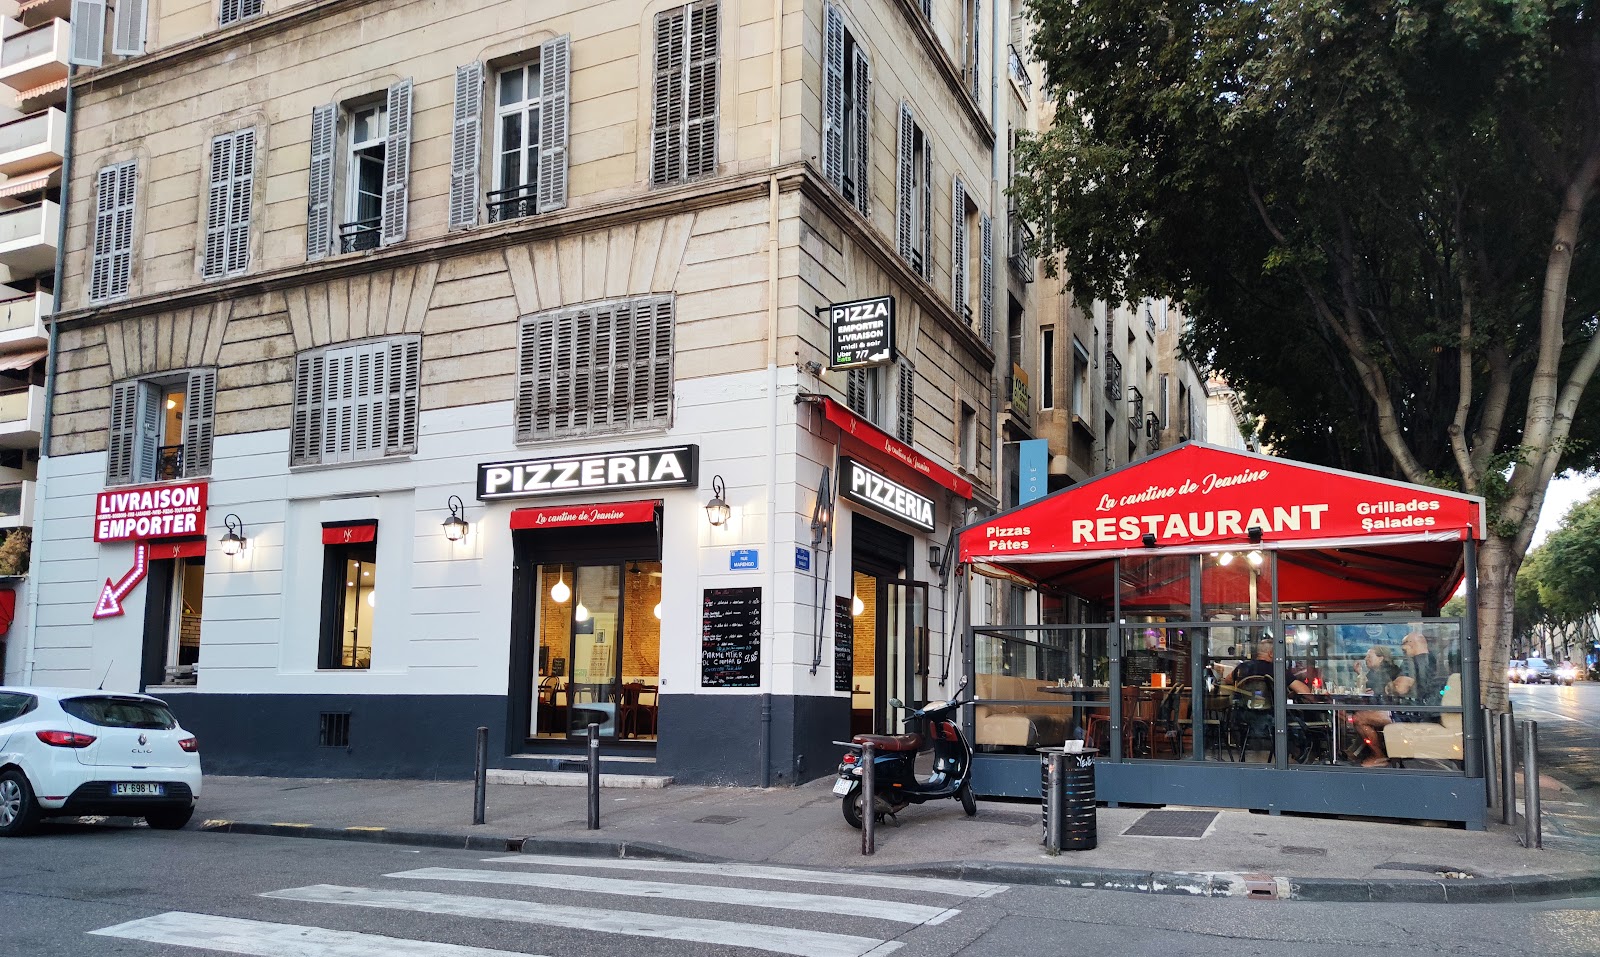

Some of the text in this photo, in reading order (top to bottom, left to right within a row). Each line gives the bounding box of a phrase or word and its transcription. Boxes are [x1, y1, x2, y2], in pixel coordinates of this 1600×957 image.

[834, 302, 888, 323] PIZZA
[838, 320, 884, 333] EMPORTER
[838, 330, 883, 342] LIVRAISON
[856, 350, 869, 359] 7/7
[486, 453, 684, 493] PIZZERIA
[852, 466, 933, 525] PIZZERIA
[1096, 468, 1269, 512] La cantine de Jeanine
[100, 487, 199, 513] LIVRAISON
[1356, 499, 1440, 516] Grillades
[535, 509, 624, 524] La cantine de Jeanine
[1072, 504, 1328, 544] RESTAURANT
[1361, 515, 1435, 531] Salades
[99, 513, 196, 539] EMPORTER
[986, 526, 1031, 538] Pizzas
[989, 539, 1029, 550] Pâtes
[118, 784, 158, 792] EV-698-LY
